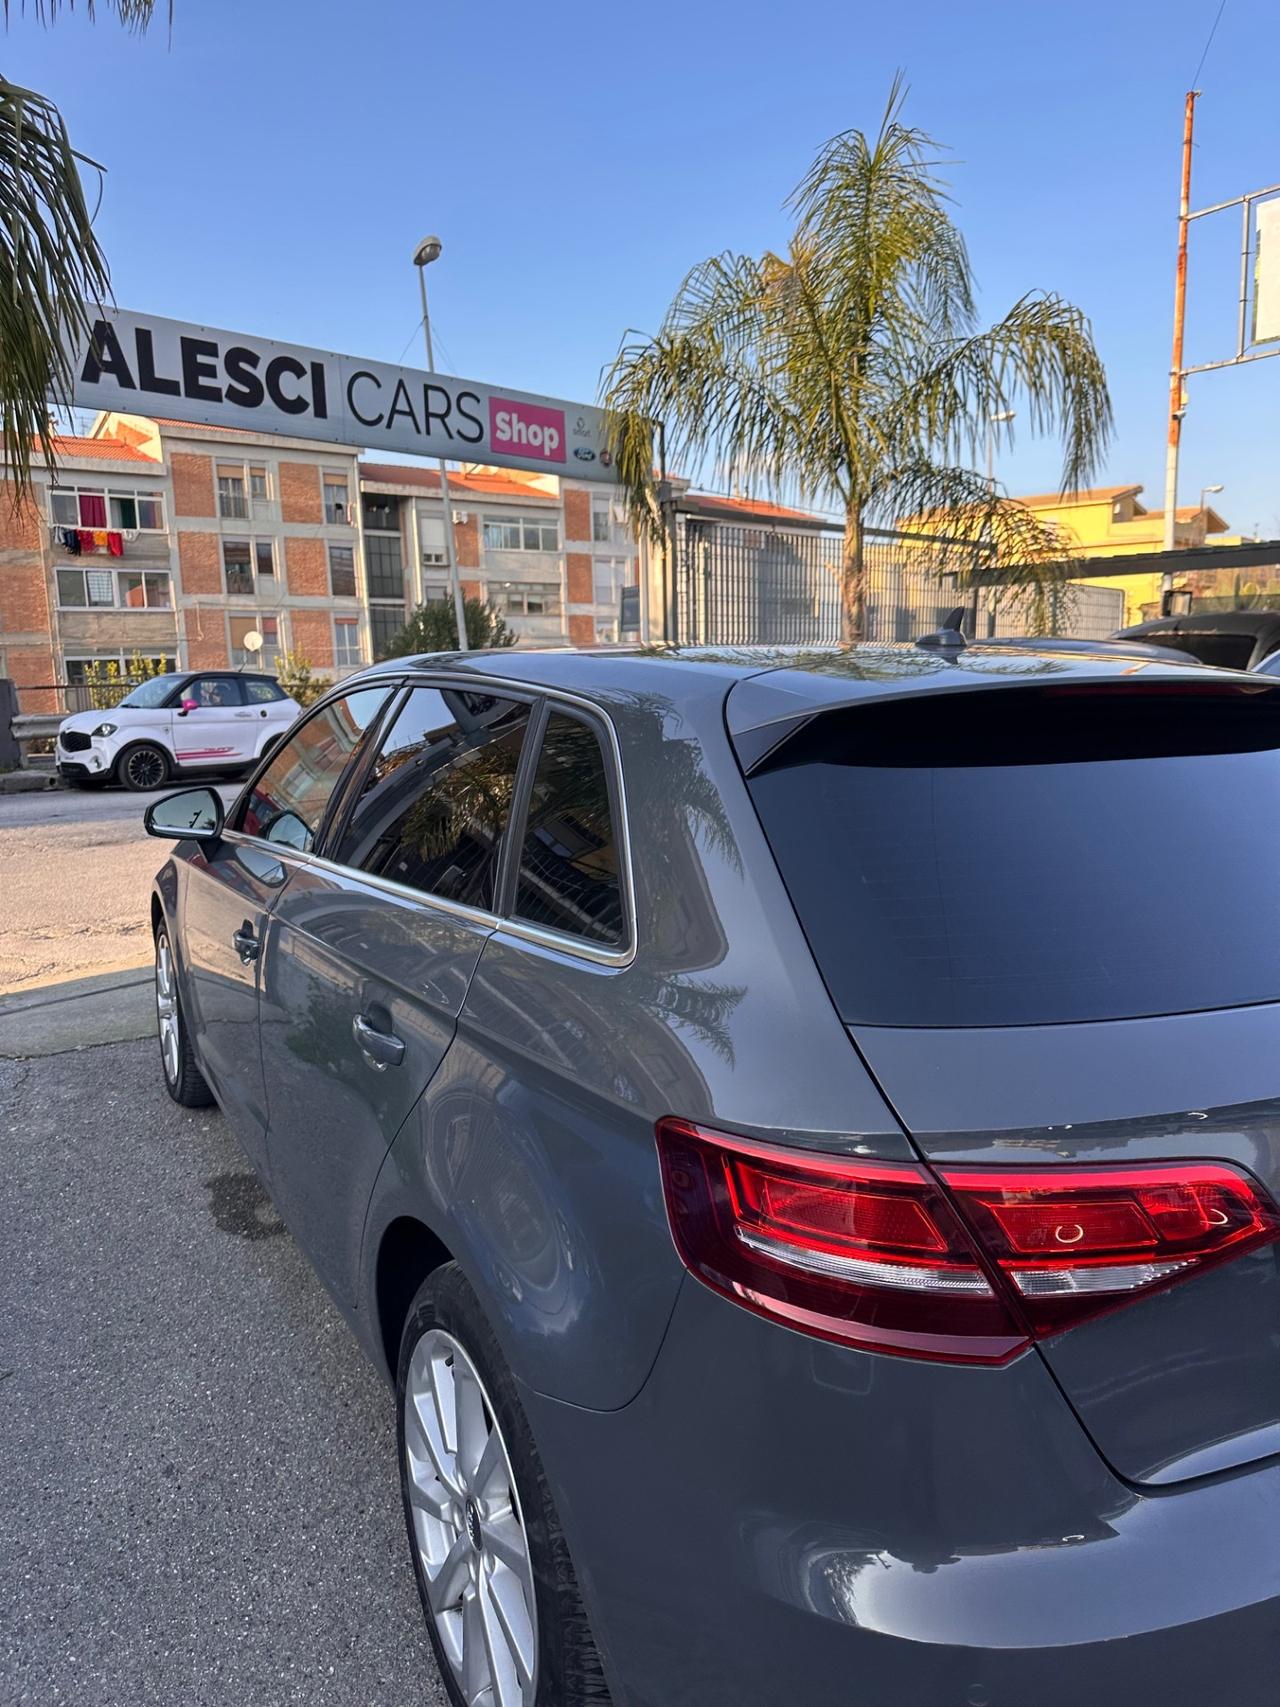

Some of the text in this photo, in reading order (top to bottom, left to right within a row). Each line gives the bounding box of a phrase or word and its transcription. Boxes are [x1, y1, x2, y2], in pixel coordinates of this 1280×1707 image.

[81, 320, 560, 456] ALESCI CARS Shop
